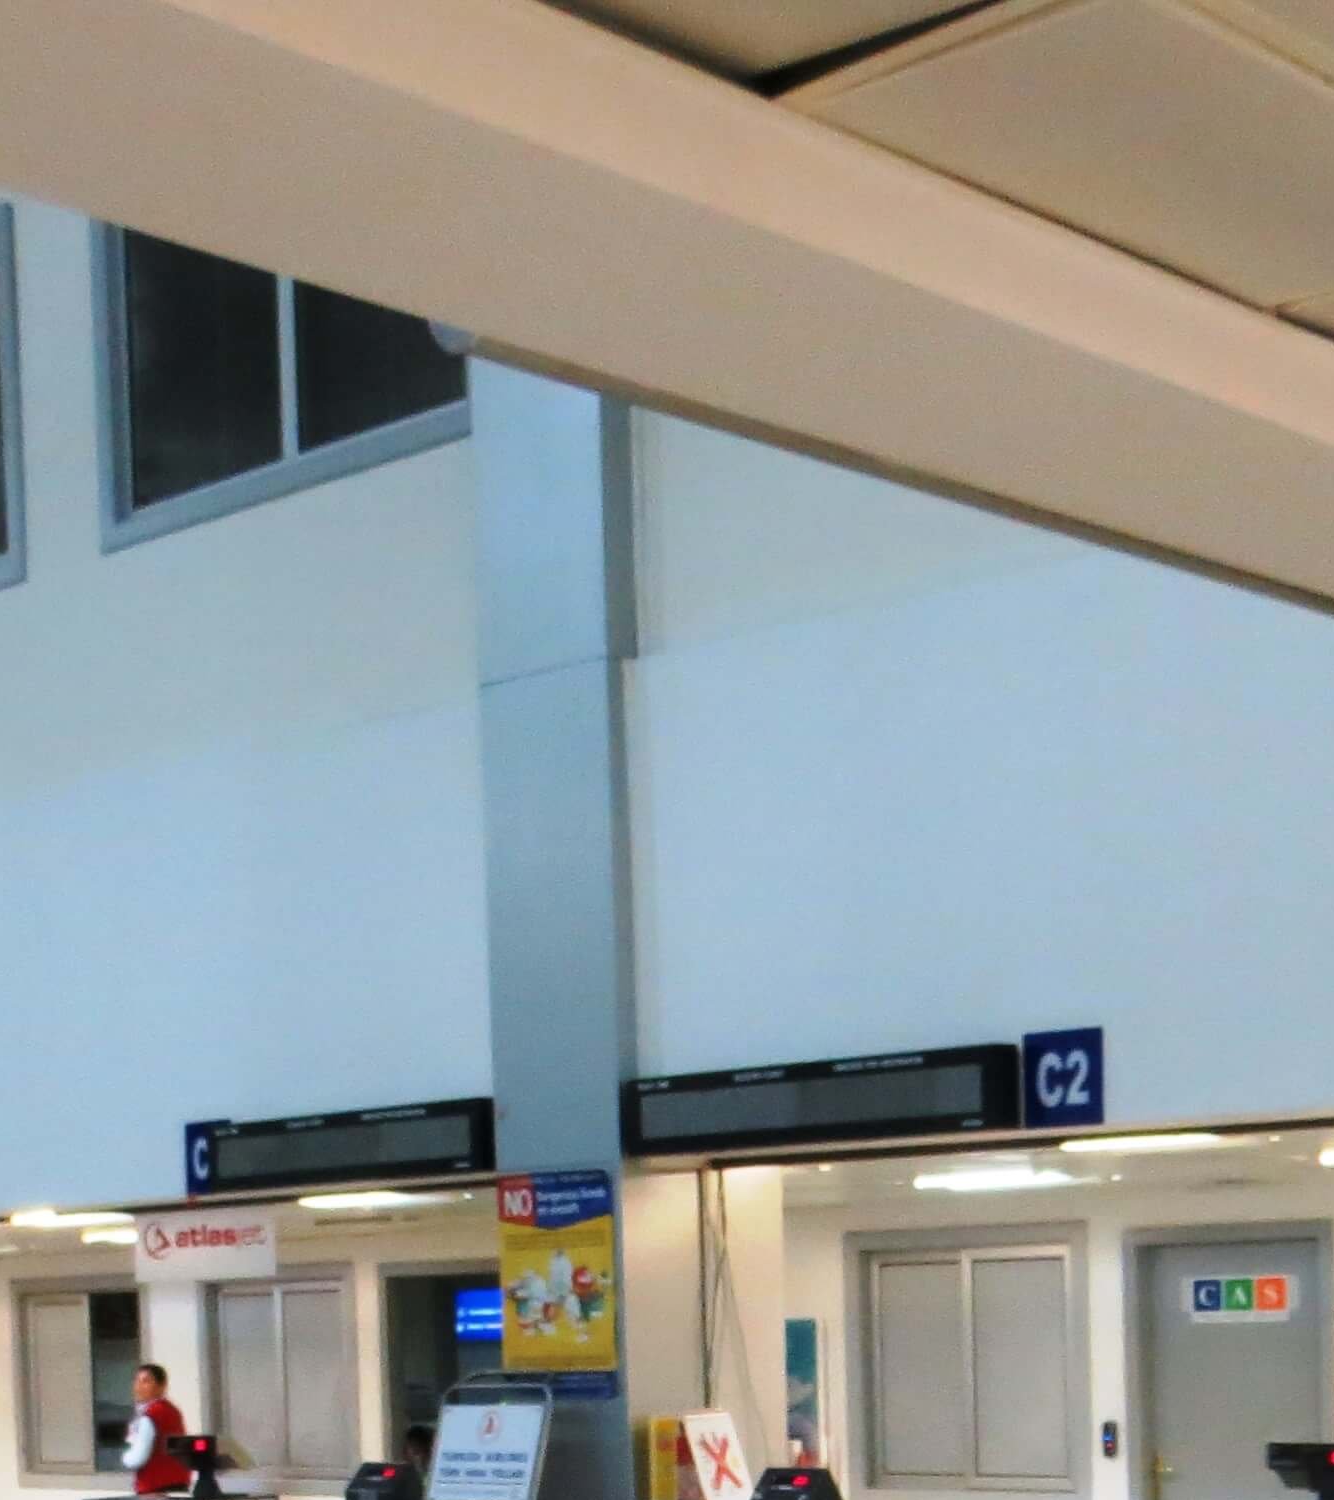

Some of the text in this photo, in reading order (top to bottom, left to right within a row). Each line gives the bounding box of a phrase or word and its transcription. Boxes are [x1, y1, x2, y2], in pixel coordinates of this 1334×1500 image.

[1037, 1050, 1089, 1107] C2
[192, 1136, 209, 1180] C
[503, 1188, 533, 1217] NO
[1198, 1284, 1279, 1307] CAS
